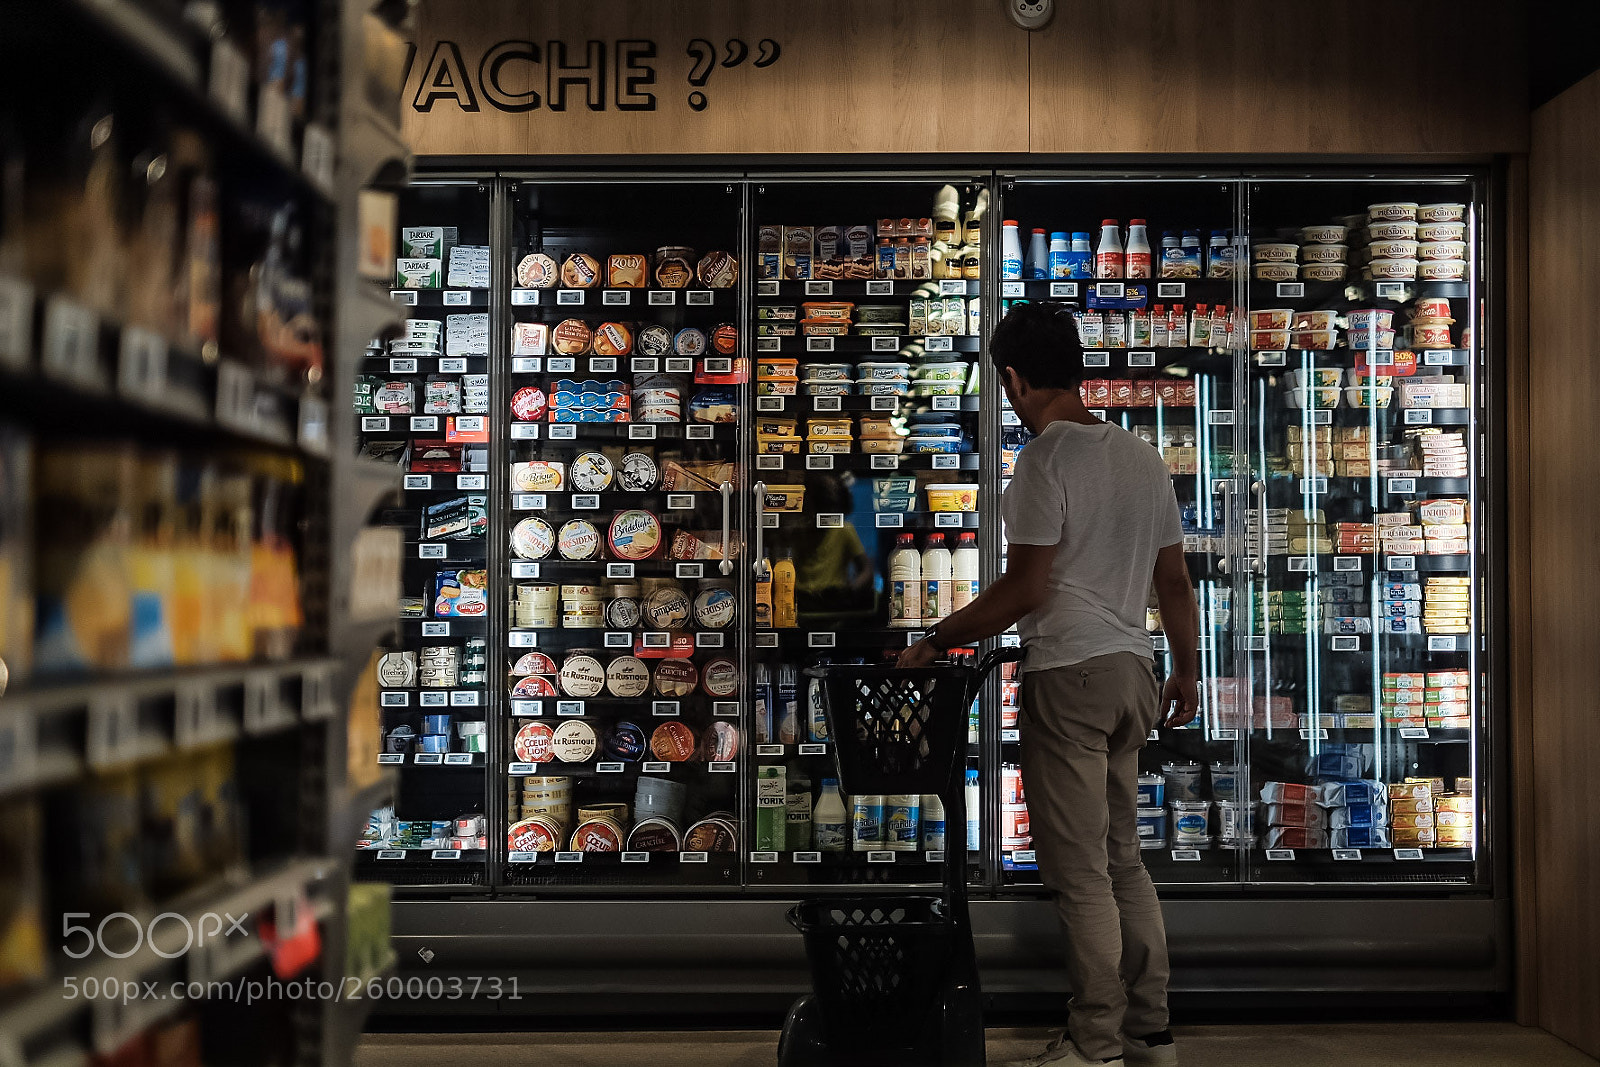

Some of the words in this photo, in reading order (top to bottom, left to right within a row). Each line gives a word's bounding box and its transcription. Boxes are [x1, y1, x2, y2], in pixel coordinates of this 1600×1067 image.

[402, 39, 658, 113] ACHE
[409, 231, 435, 241] TARTARE
[403, 261, 430, 271] TARTARE
[1394, 351, 1413, 360] 50%
[613, 516, 654, 536] Bridelight
[562, 671, 571, 680] LE
[570, 671, 603, 684] RUSTIQUE
[607, 671, 616, 680] LE
[616, 671, 649, 683] RUSTIQUE
[554, 739, 561, 747] LE
[561, 737, 595, 748] RUSTIQUE
[527, 748, 547, 757] LION
[758, 797, 785, 806] YORIK
